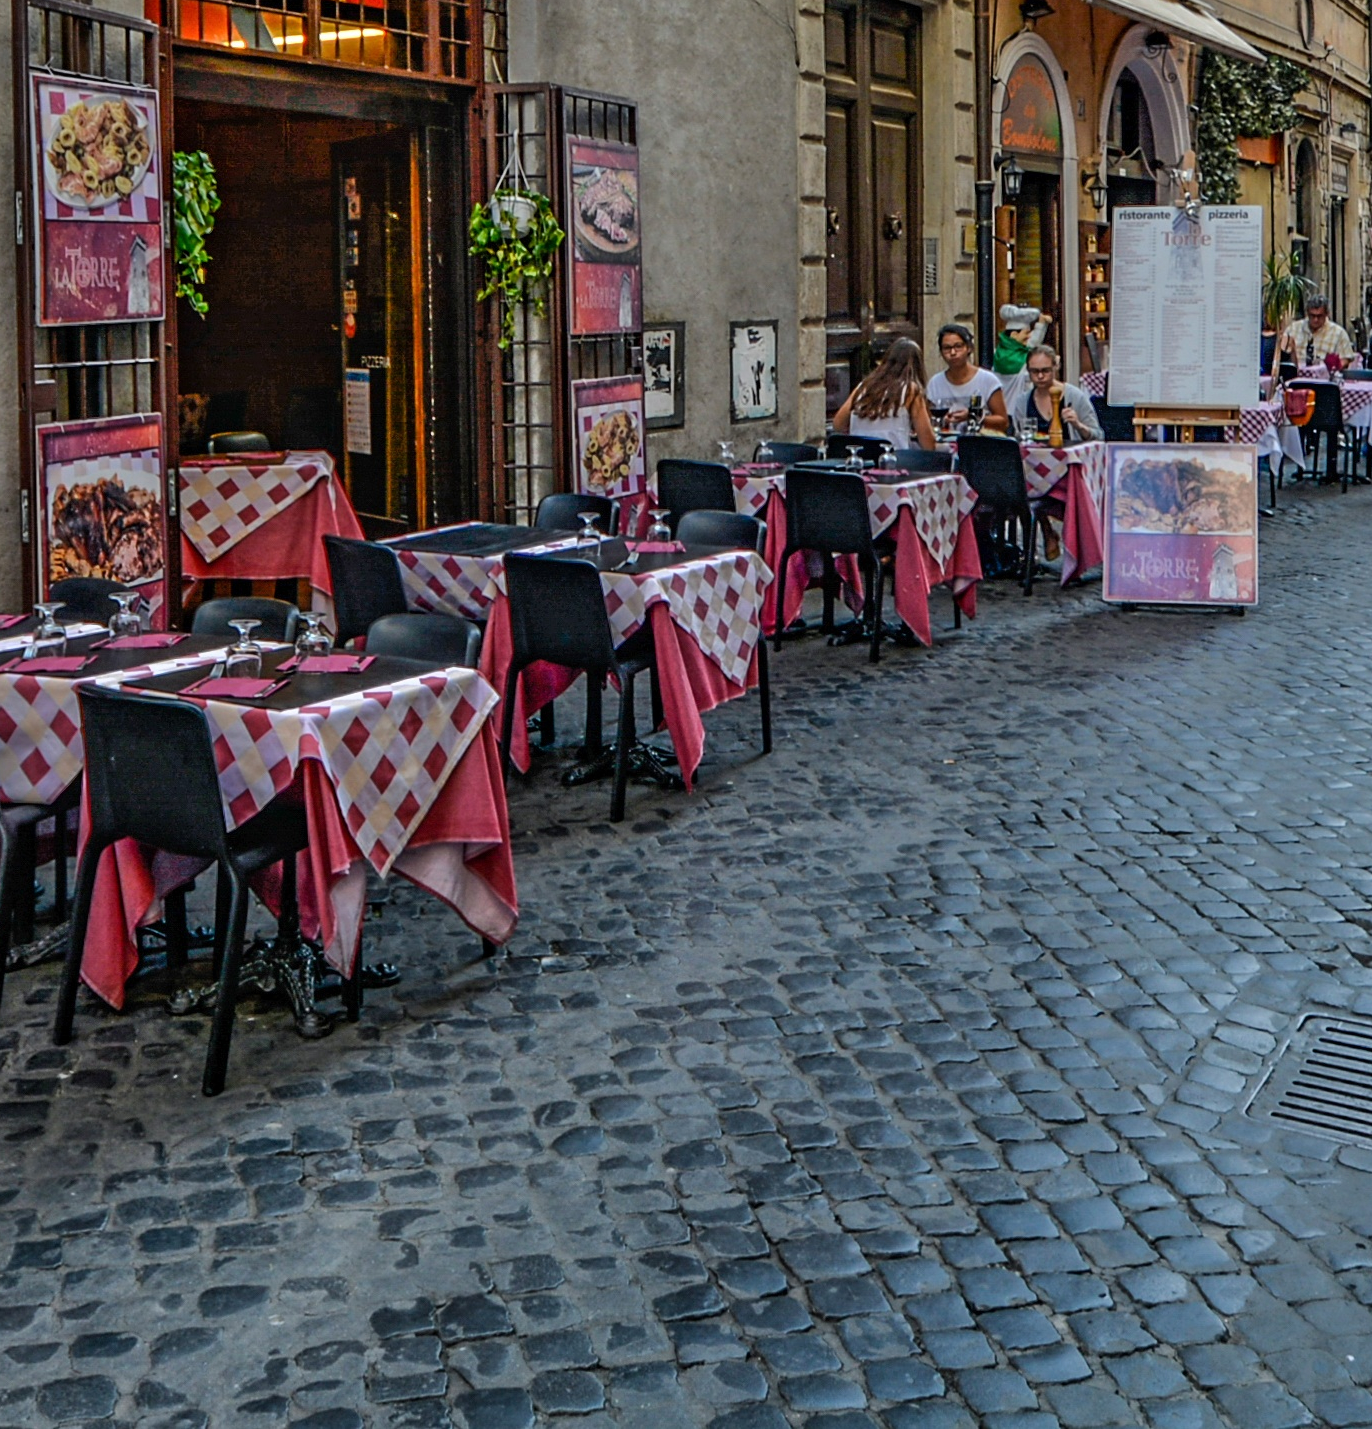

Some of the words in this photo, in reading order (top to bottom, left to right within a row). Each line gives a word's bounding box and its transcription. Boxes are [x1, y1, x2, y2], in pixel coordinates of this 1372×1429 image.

[1118, 210, 1172, 221] ristorante
[1208, 209, 1249, 222] pizzeria
[1162, 230, 1213, 248] Torre
[1133, 550, 1200, 582] TORRE
